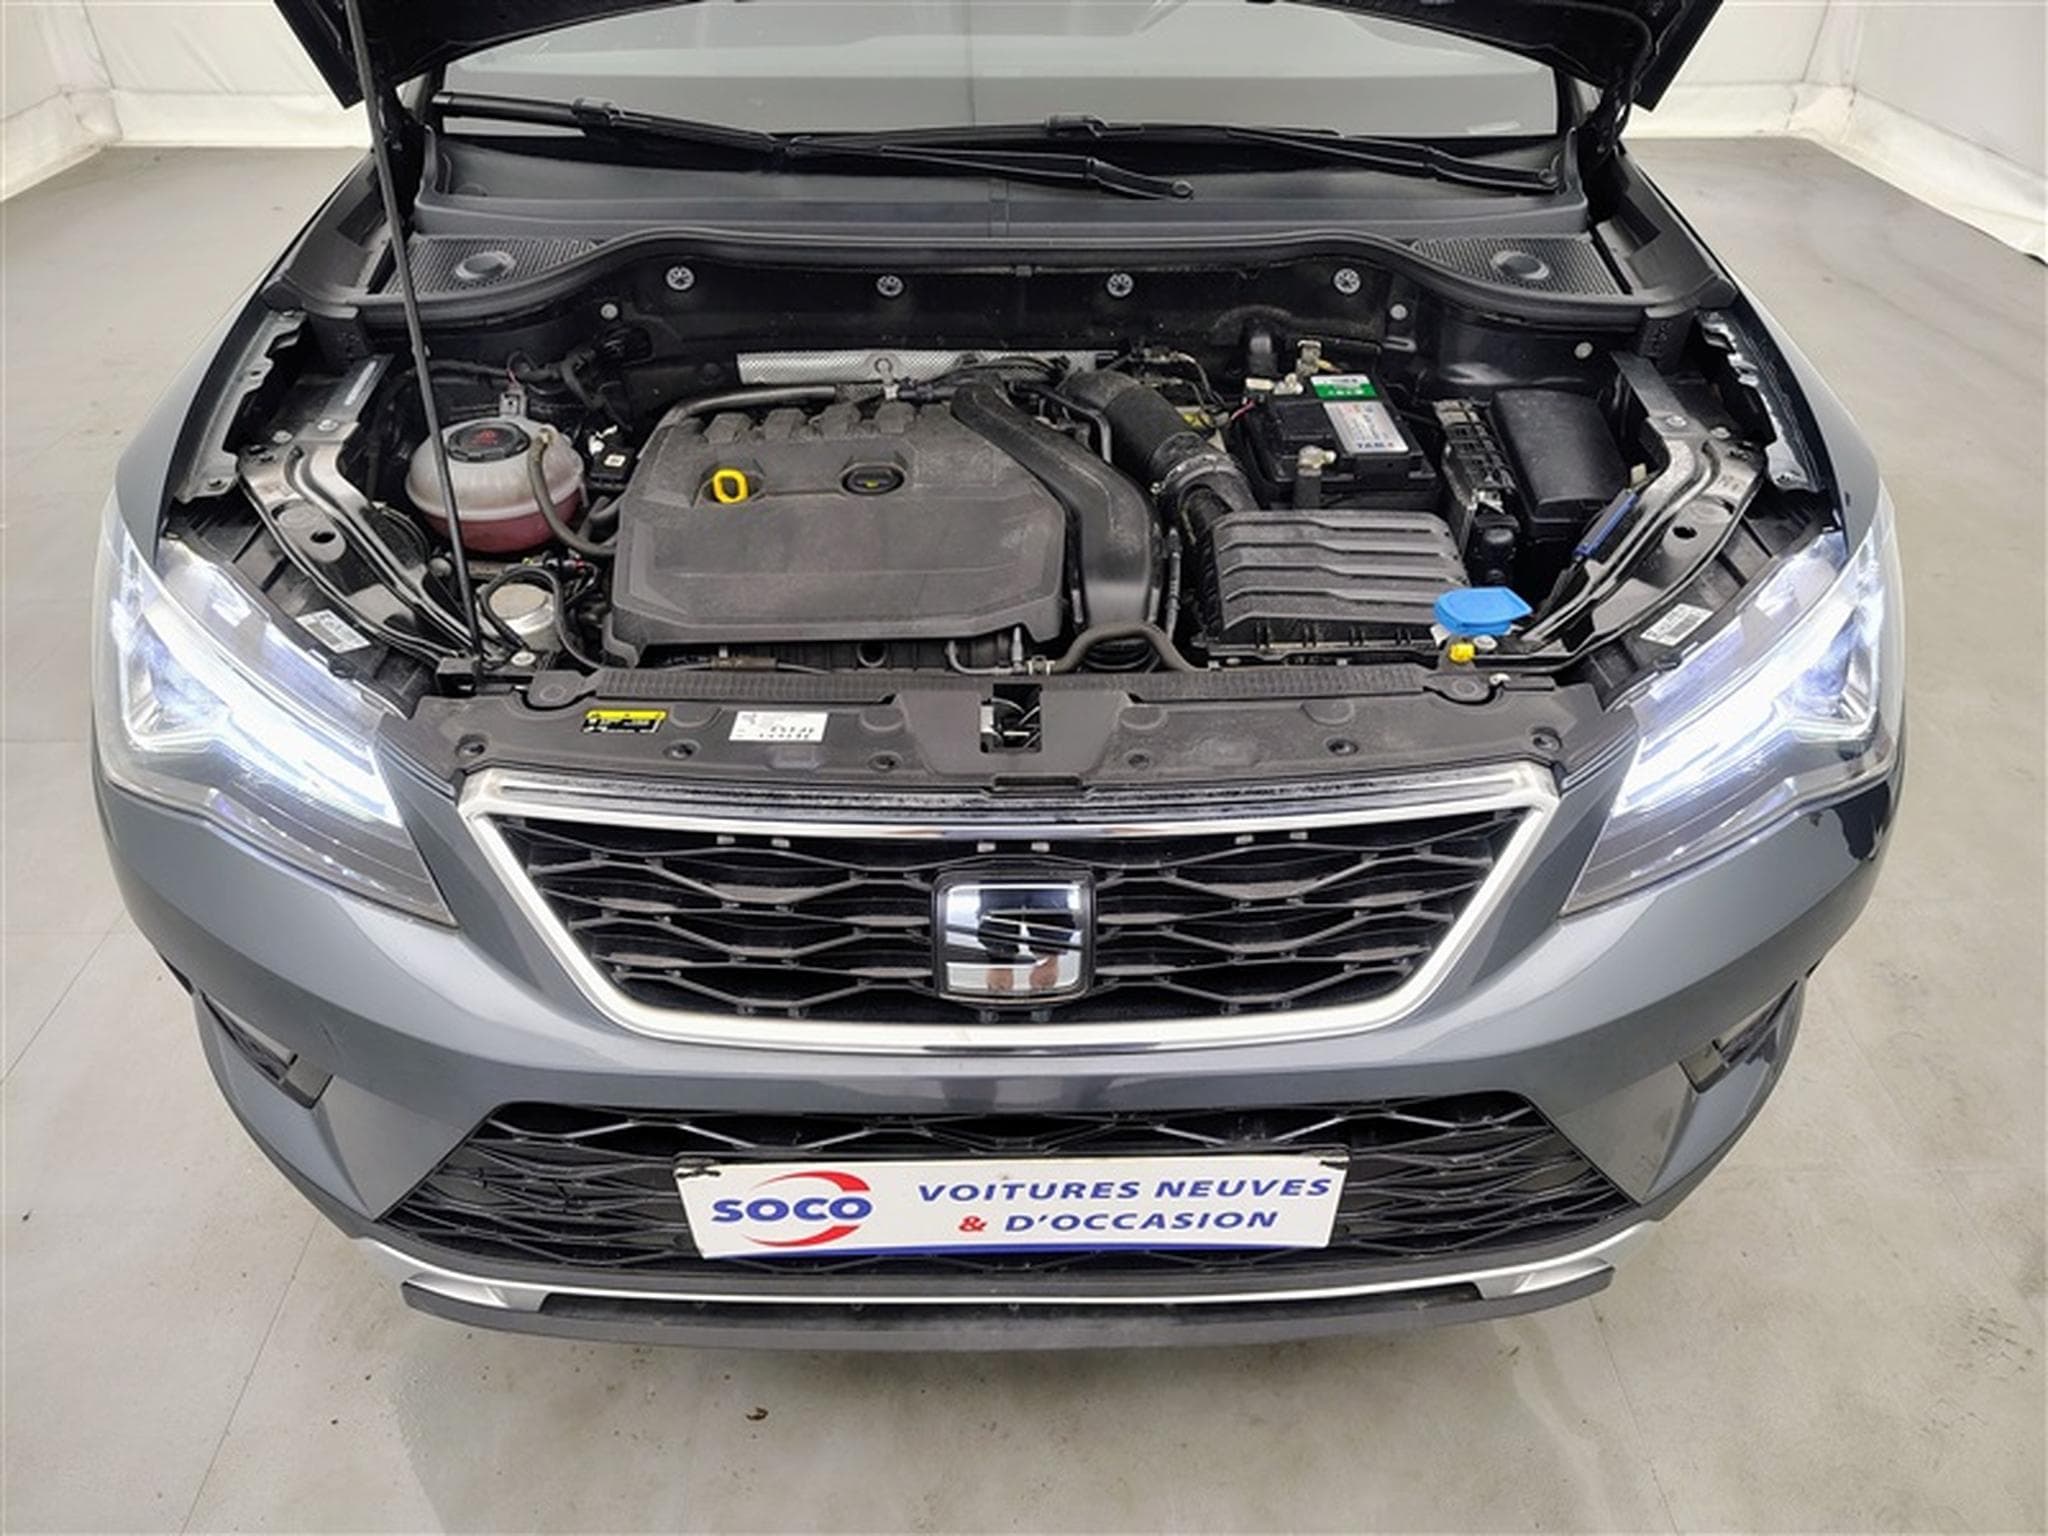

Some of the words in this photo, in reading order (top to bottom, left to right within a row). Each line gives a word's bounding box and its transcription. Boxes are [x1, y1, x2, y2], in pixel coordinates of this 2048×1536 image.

[918, 1181, 1140, 1201] VOITURES
[1153, 1178, 1331, 1198] NEUVES
[711, 1196, 873, 1223] SOCO
[959, 1216, 986, 1233] &
